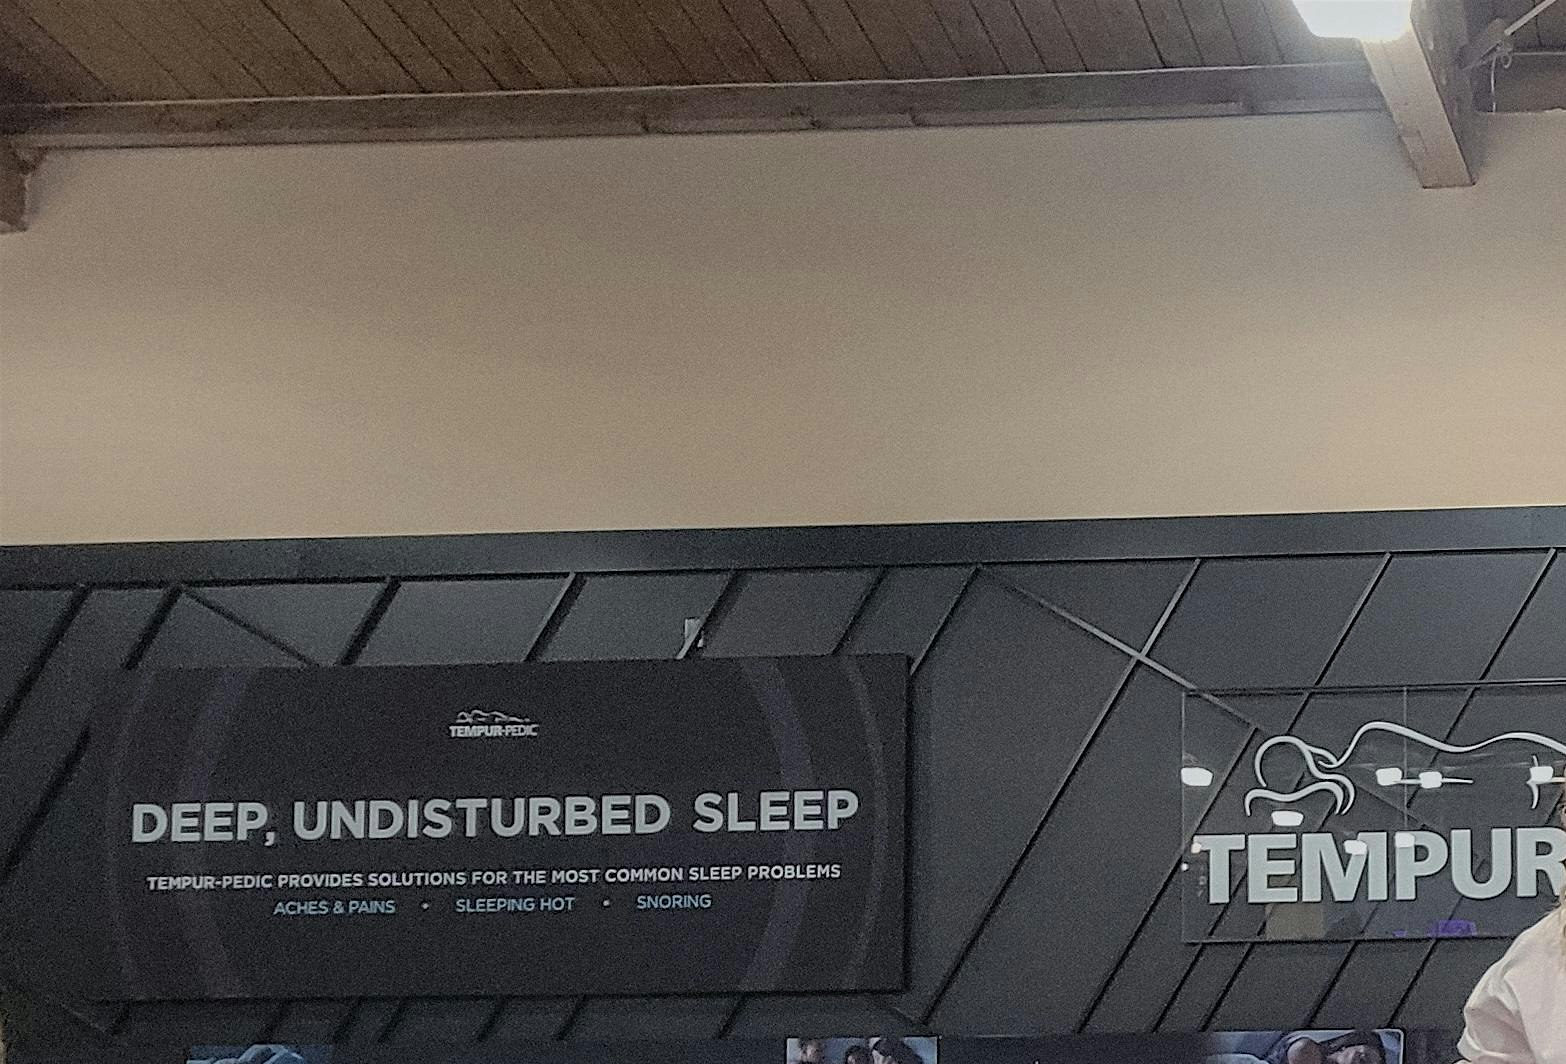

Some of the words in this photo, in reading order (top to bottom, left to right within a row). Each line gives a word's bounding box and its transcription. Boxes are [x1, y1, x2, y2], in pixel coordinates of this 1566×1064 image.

[449, 724, 540, 738] TEMPUR-PEDIC
[131, 801, 276, 847] DEEP,
[292, 793, 671, 840] UNDISTURBED
[692, 788, 860, 832] SLEEP
[147, 874, 273, 891] TEMPUR-PEDIC
[277, 872, 364, 888] PROVIDES
[367, 871, 468, 887] SOLUTIONS
[471, 870, 508, 886] FOR
[513, 869, 547, 884] THE
[551, 868, 600, 883] MOST
[604, 866, 684, 883] COMMON
[688, 866, 743, 881] SLEEP
[747, 864, 842, 880] PROBLEMS
[273, 900, 330, 915] ACHES
[332, 899, 345, 914] &
[348, 898, 397, 914] PAINS
[455, 897, 536, 912] SLEEPING
[540, 896, 576, 911] HOT
[636, 894, 713, 909] SNORING
